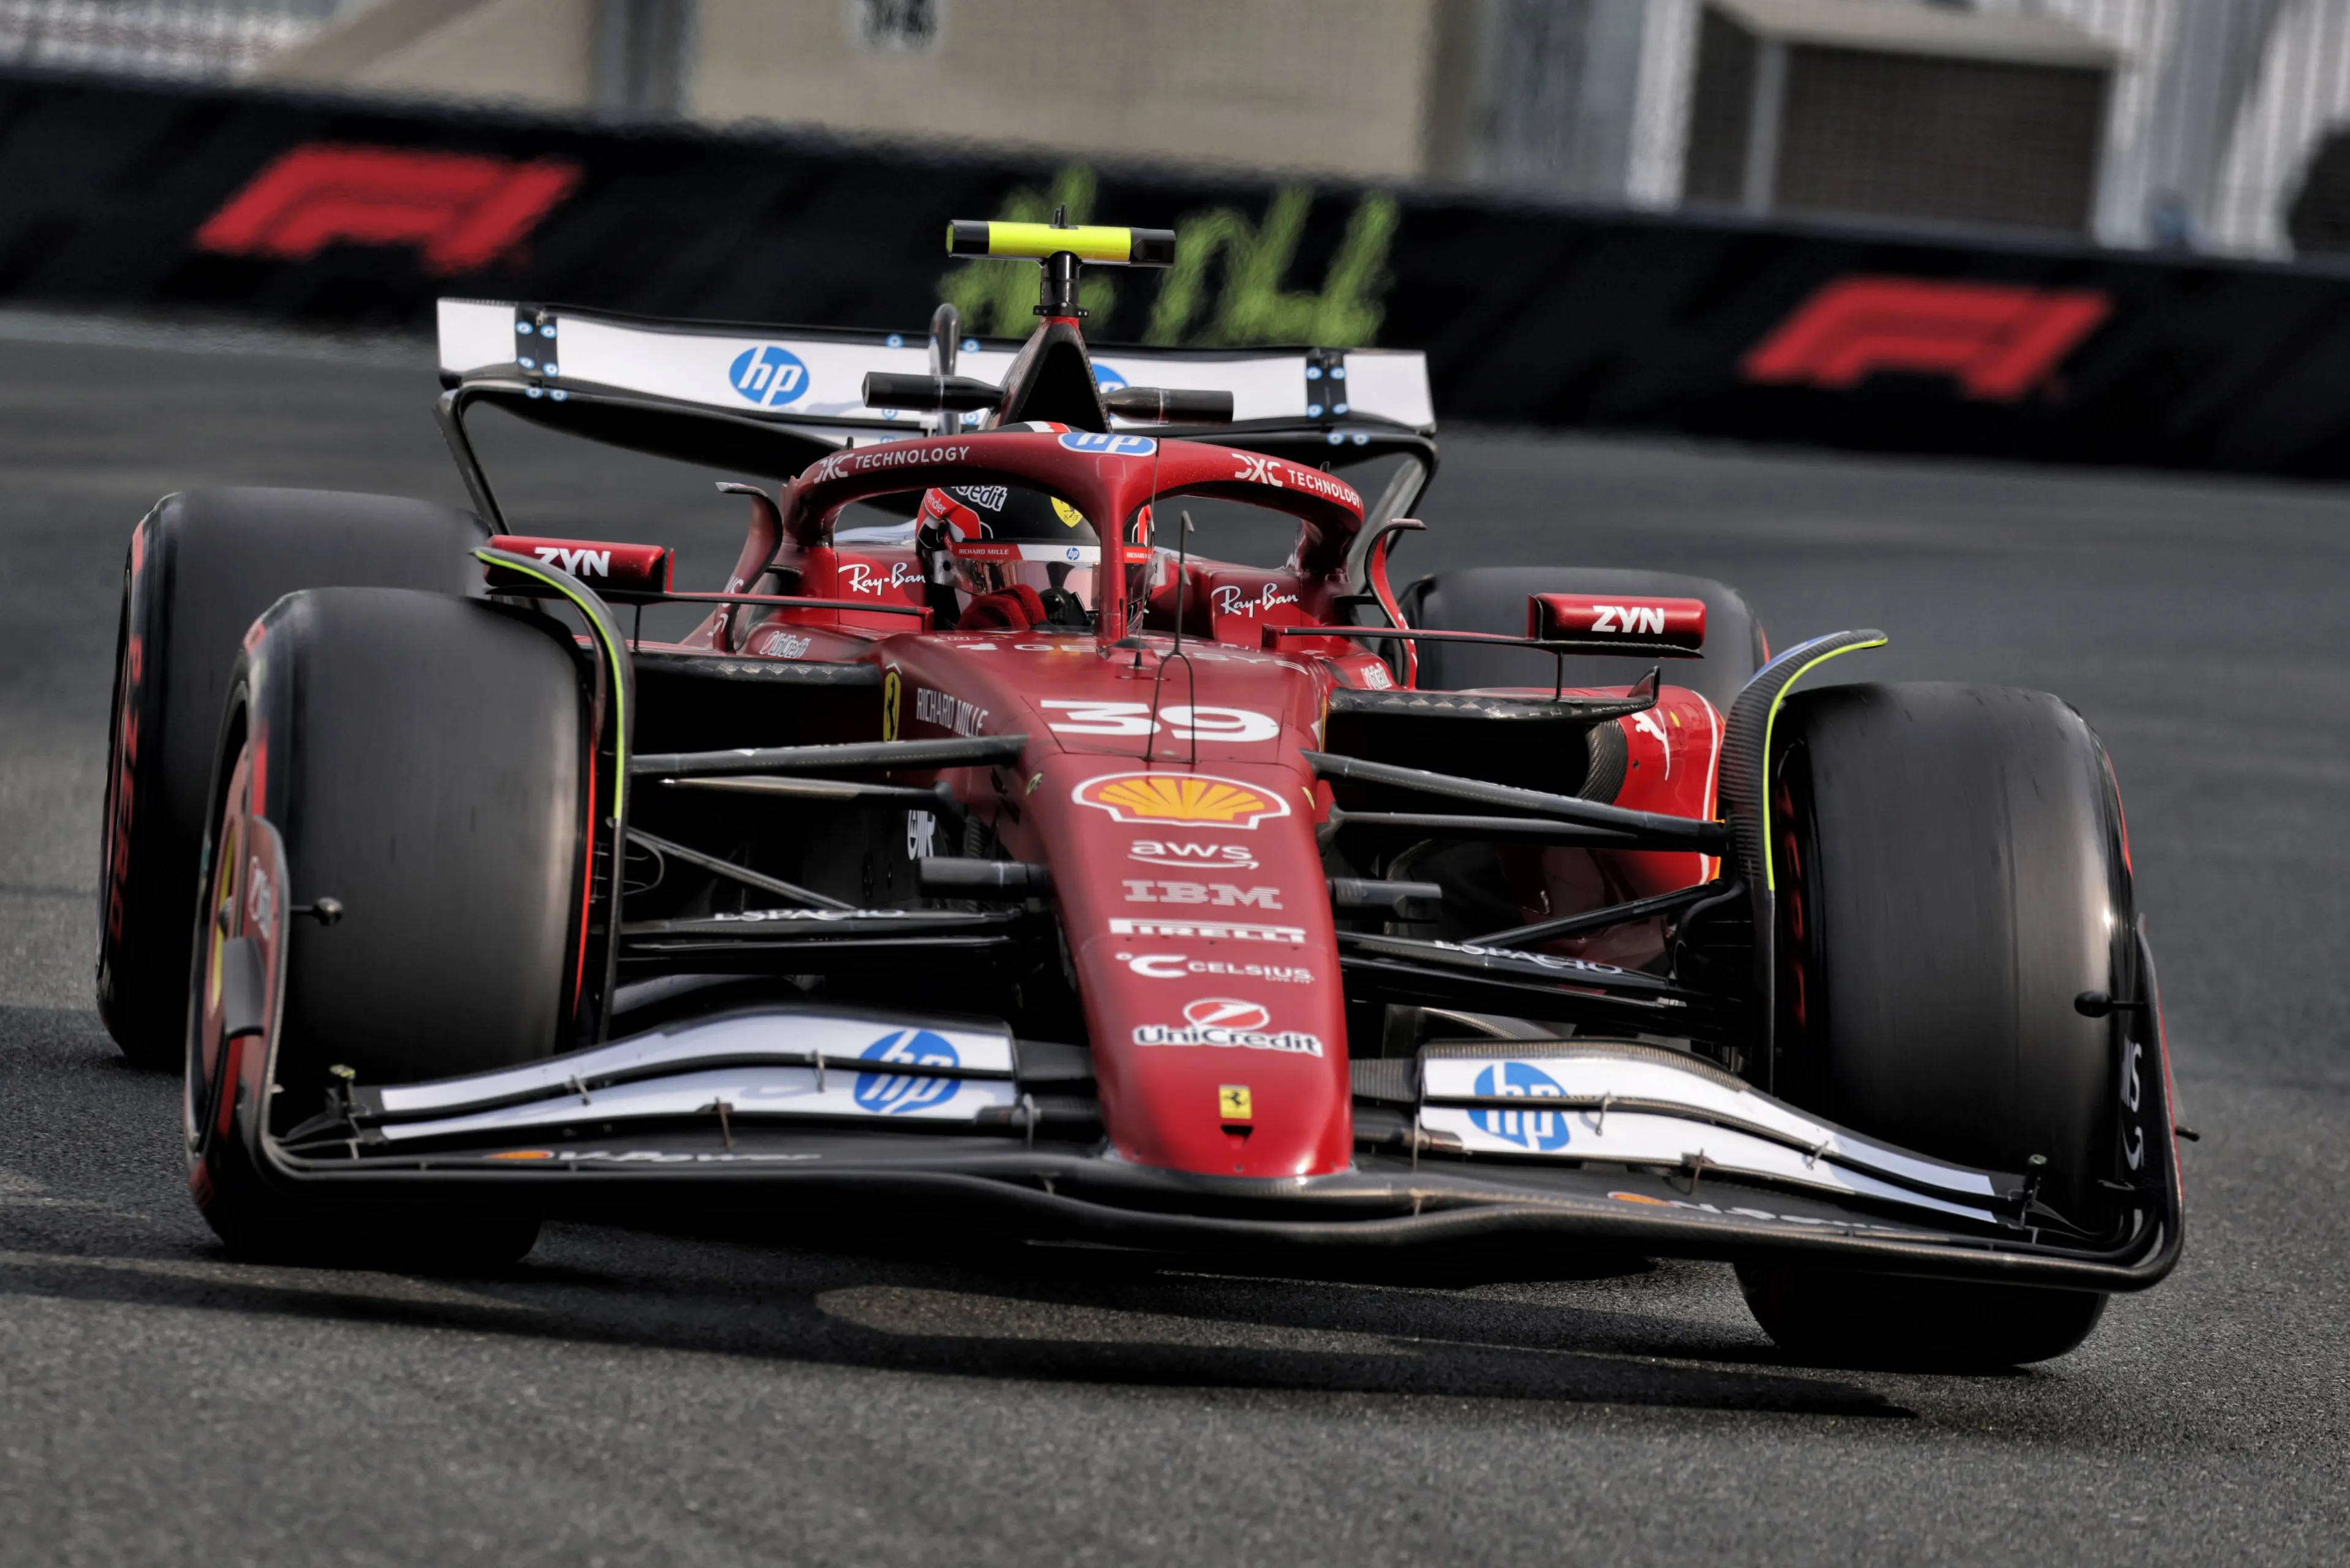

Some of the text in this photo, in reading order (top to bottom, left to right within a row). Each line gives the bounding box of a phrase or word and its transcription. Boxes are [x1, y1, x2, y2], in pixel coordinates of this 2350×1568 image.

[738, 346, 804, 405] hp
[1075, 432, 1143, 452] hp
[855, 446, 969, 469] TECHNOLOGY
[1287, 469, 1361, 509] TECHNOLOGY
[534, 547, 611, 577] ZYN
[1067, 548, 1079, 560] hp
[838, 562, 926, 595] Ray-Ban
[1211, 582, 1299, 617] Ray-Ban
[1590, 605, 1665, 635] ZYN
[916, 687, 955, 729] RICHARD
[1041, 699, 1280, 742] 39
[1131, 840, 1252, 859] aws
[1122, 880, 1283, 910] IBM
[1109, 919, 1306, 943] PIRELLI
[1187, 961, 1311, 981] CELSIUS
[1135, 1026, 1321, 1055] UniCredit
[859, 1030, 955, 1114] hp
[1484, 1063, 1560, 1149] hp
